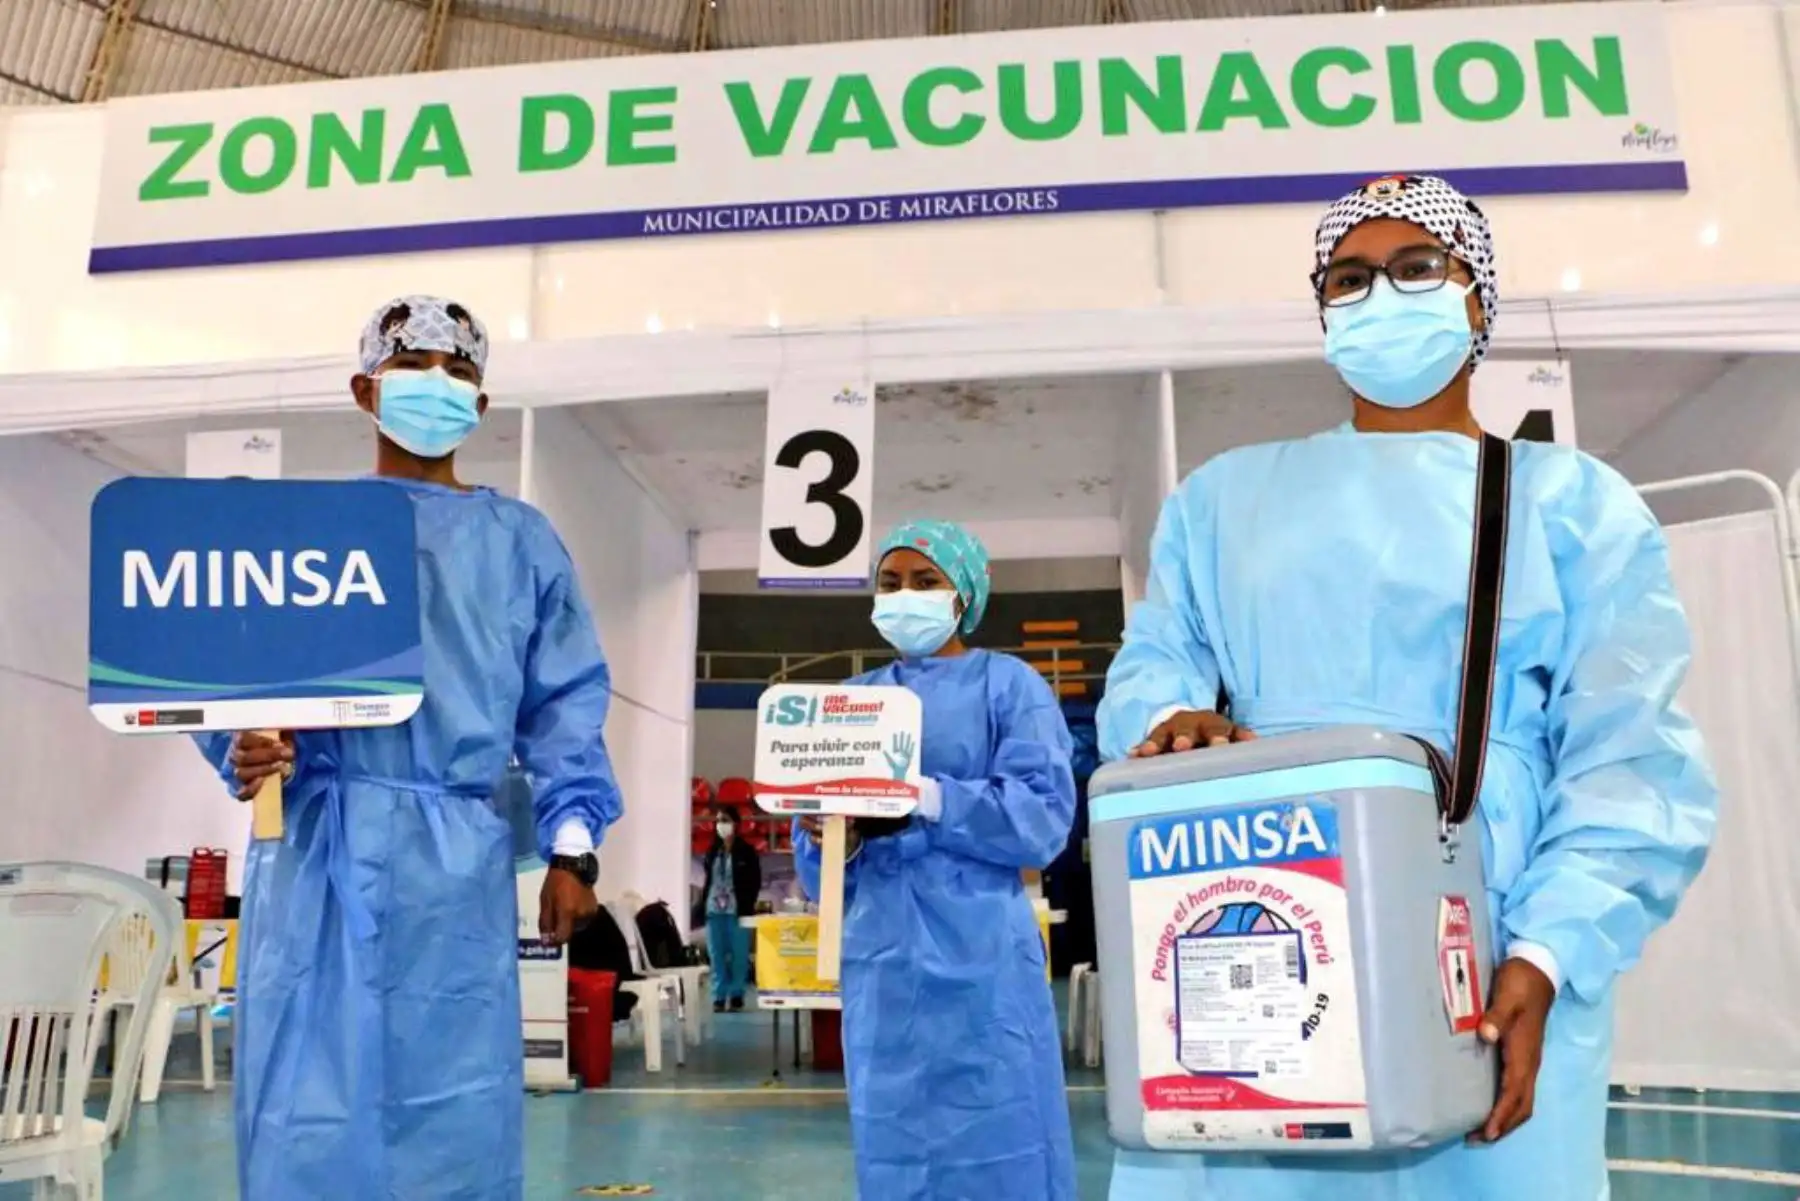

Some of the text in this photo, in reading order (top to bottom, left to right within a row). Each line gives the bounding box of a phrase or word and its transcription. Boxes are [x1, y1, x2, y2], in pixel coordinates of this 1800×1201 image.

[139, 35, 1629, 201] ZONA DE VACUNACION
[643, 190, 1059, 233] MUNICIPALIDAD DE MIRAFLORES
[769, 430, 864, 568] 3
[123, 549, 387, 607] MINSA
[770, 738, 882, 753] Para vivir con
[780, 757, 865, 771] esperanza
[1140, 805, 1328, 873] MINSA
[1151, 922, 1177, 983] Pongo
[1173, 900, 1189, 924] el
[1186, 875, 1258, 909] hombro
[1258, 882, 1294, 905] por
[1291, 903, 1315, 920] el
[1304, 920, 1336, 965] Perú
